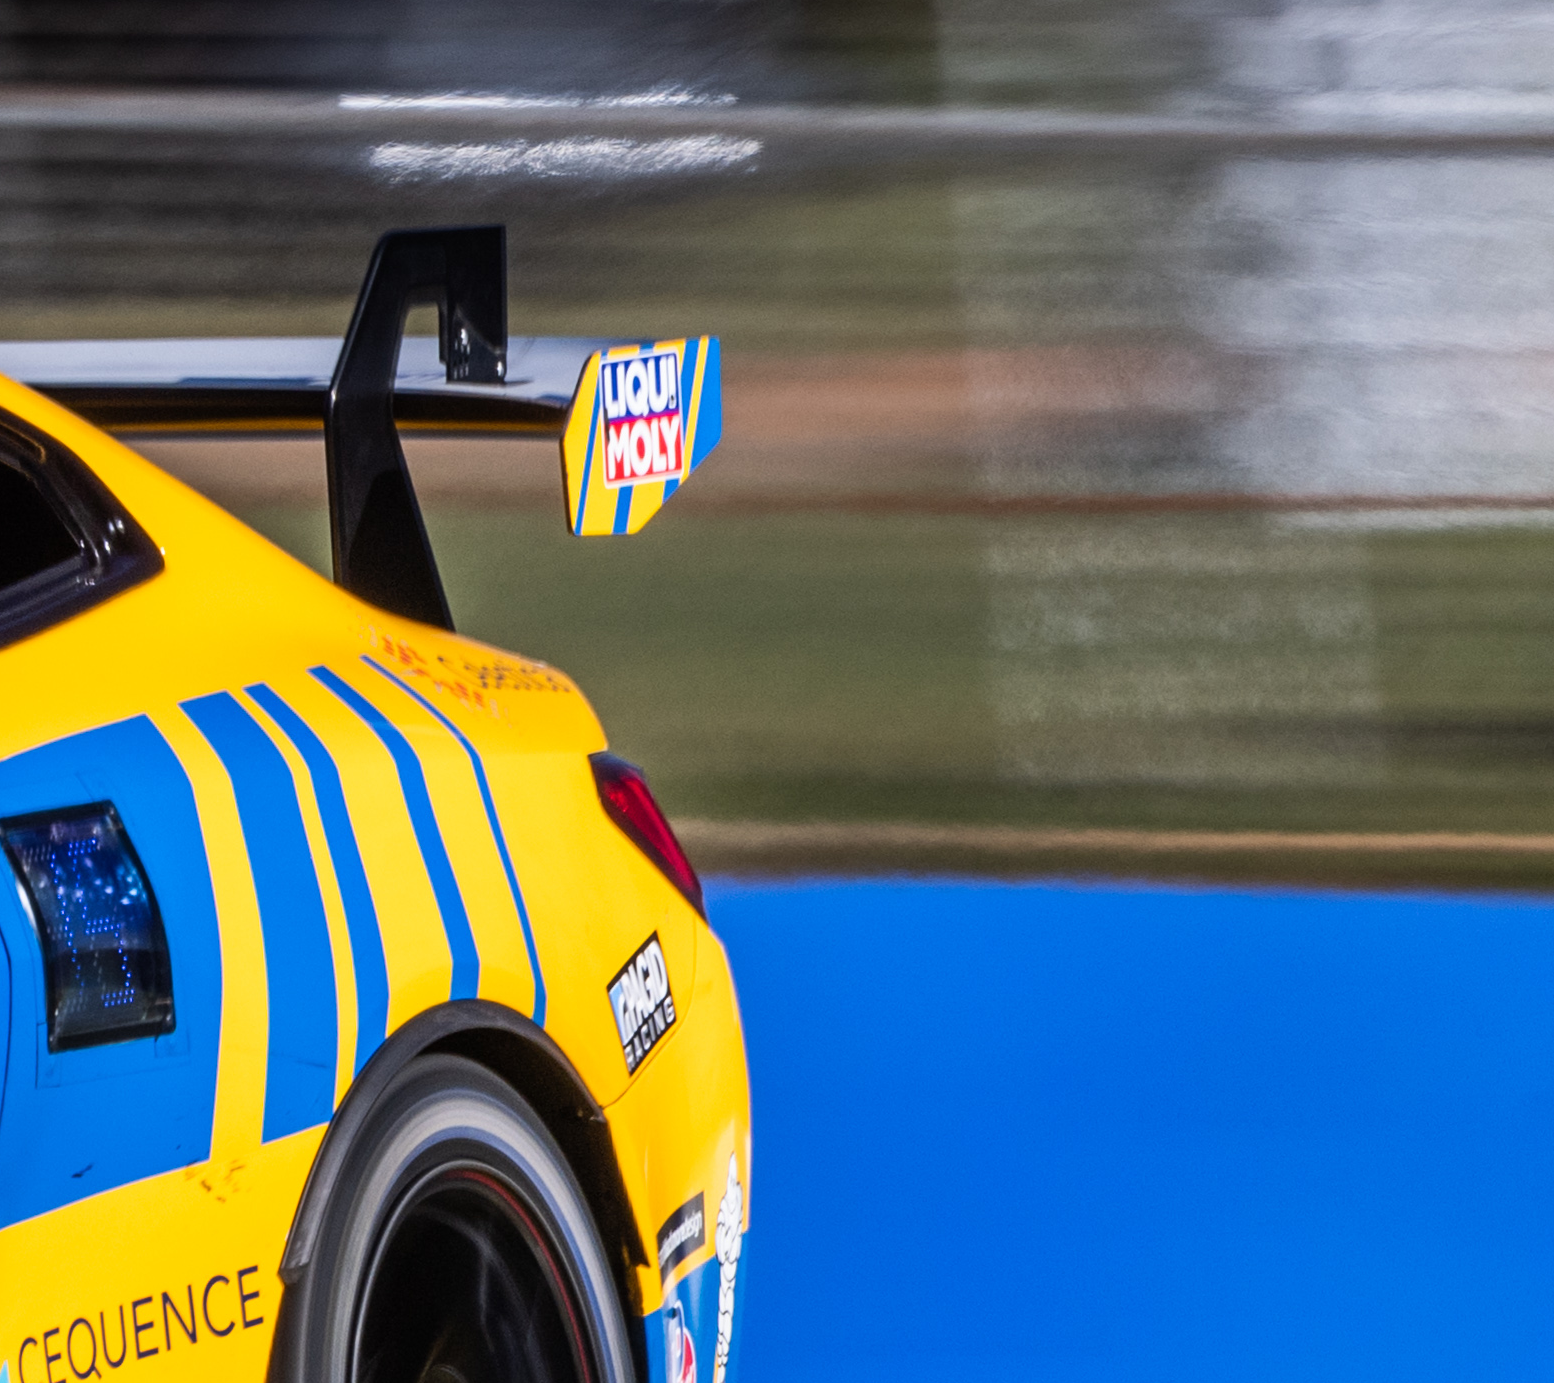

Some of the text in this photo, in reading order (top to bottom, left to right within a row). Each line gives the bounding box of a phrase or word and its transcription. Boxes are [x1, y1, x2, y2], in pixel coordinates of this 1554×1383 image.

[603, 355, 677, 418] LIQUI
[608, 415, 680, 481] MOLY
[617, 940, 668, 1046] PAGID
[624, 996, 675, 1073] RACING
